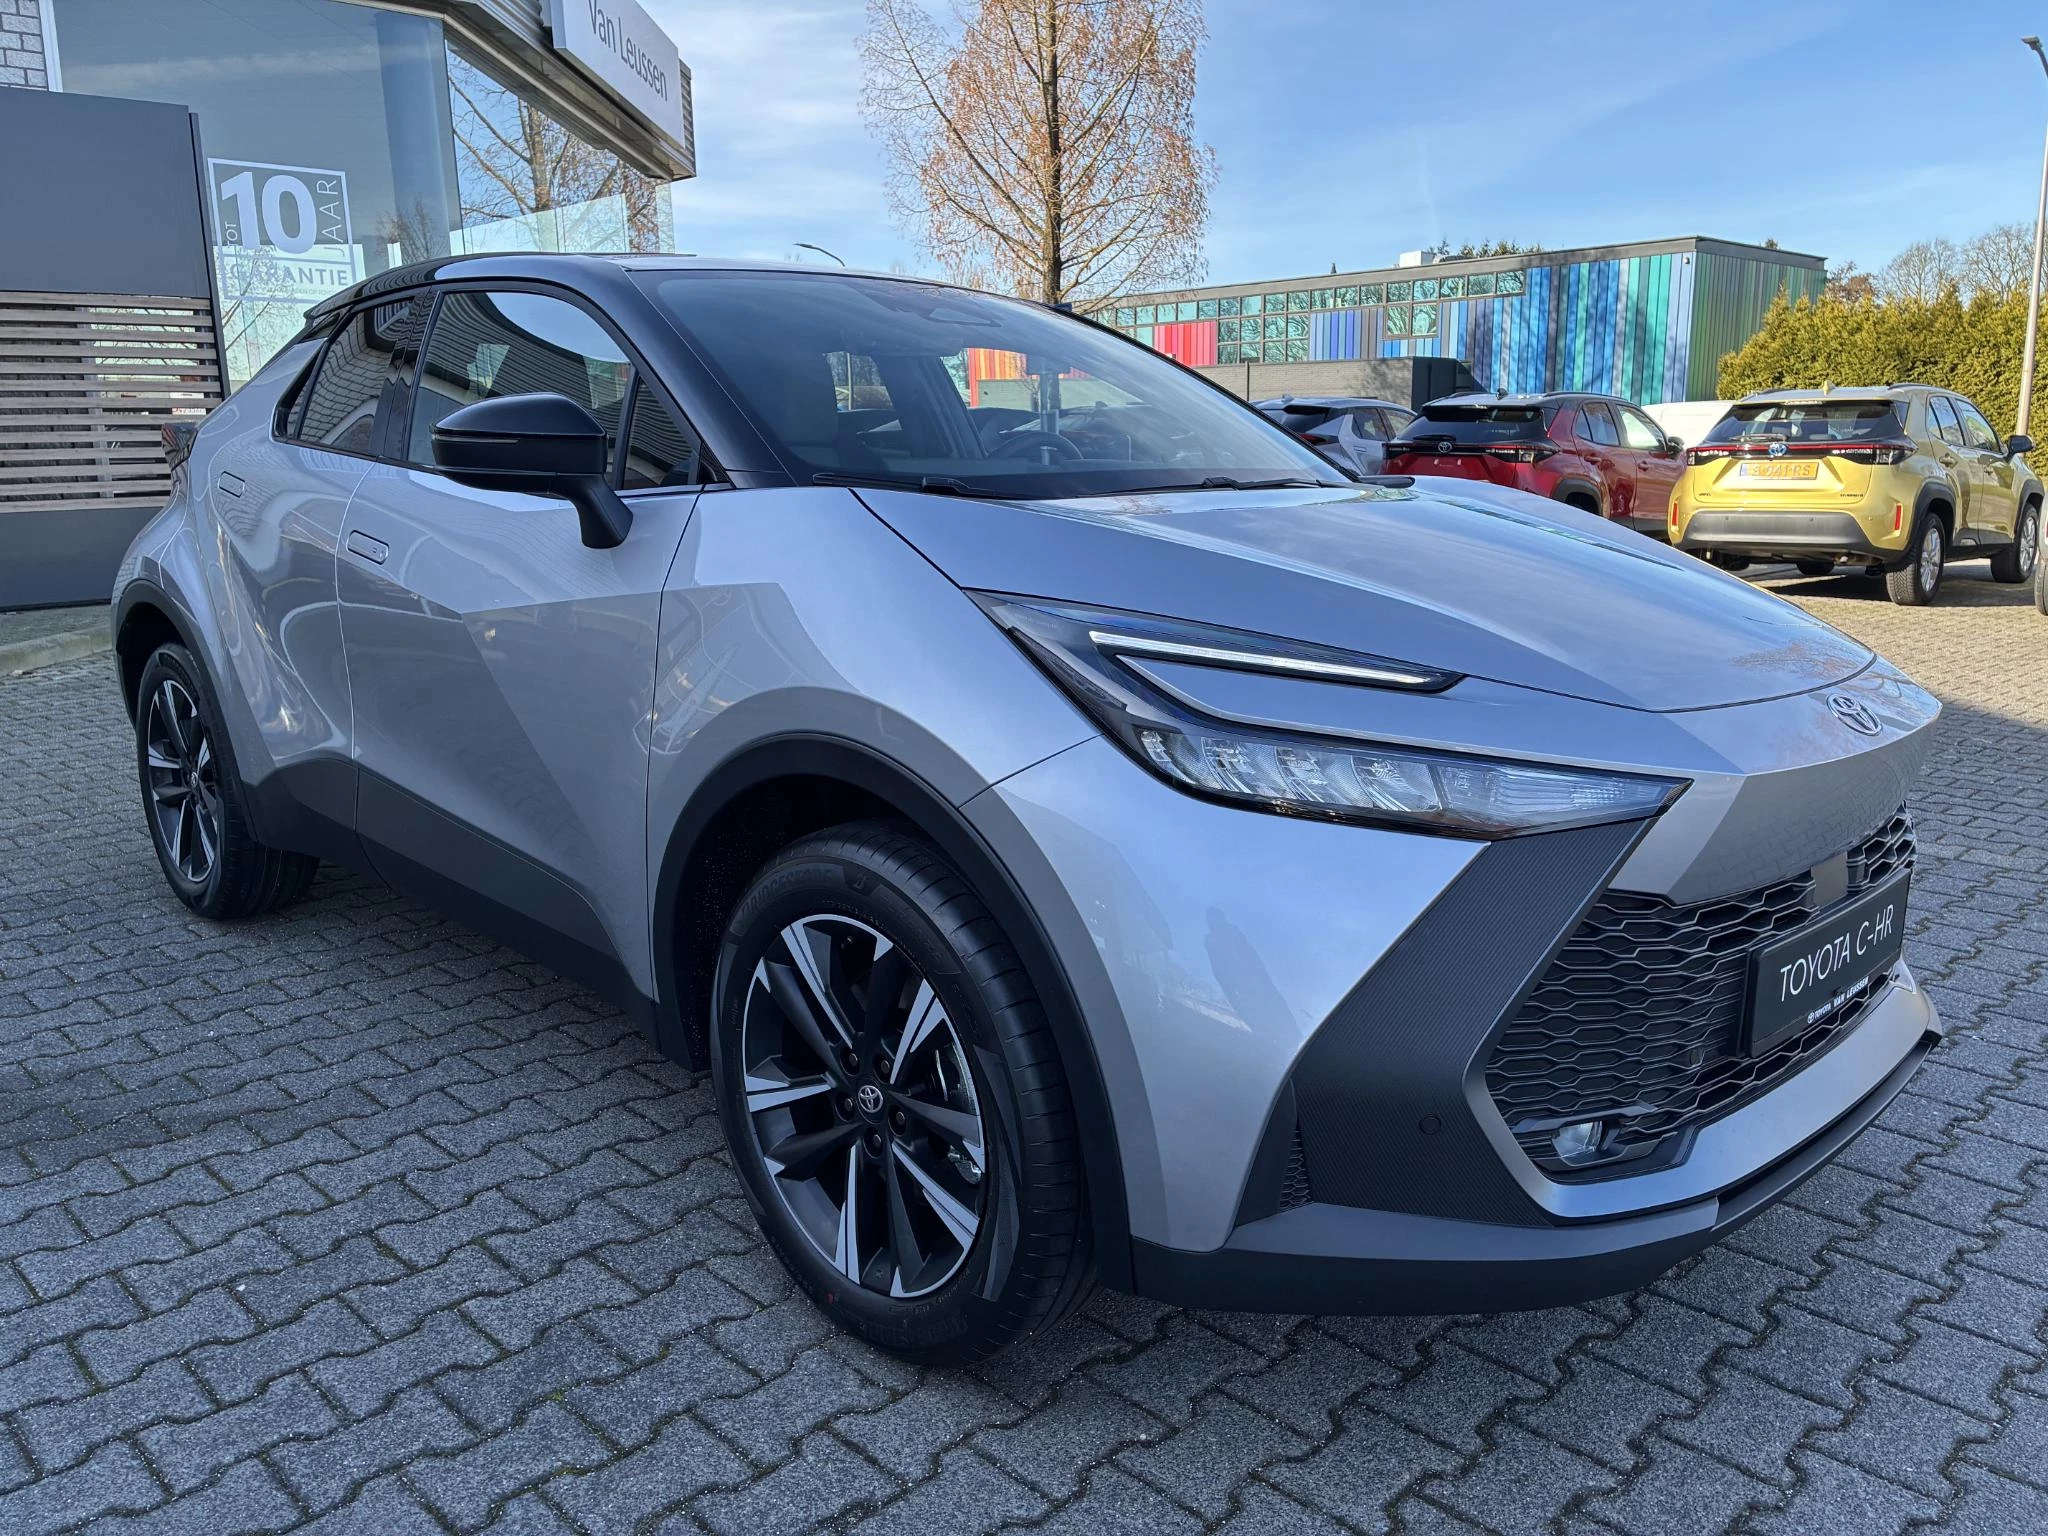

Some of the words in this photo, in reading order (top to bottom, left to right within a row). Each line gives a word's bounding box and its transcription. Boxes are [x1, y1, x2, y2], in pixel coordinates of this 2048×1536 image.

[588, 0, 616, 53] Van
[618, 17, 668, 102] Leussen
[220, 171, 317, 254] 10
[316, 180, 345, 257] JAAR
[1780, 932, 1850, 1002] TOYOTA
[1856, 904, 1894, 956] C-HR
[1846, 975, 1869, 999] LEUSSEN
